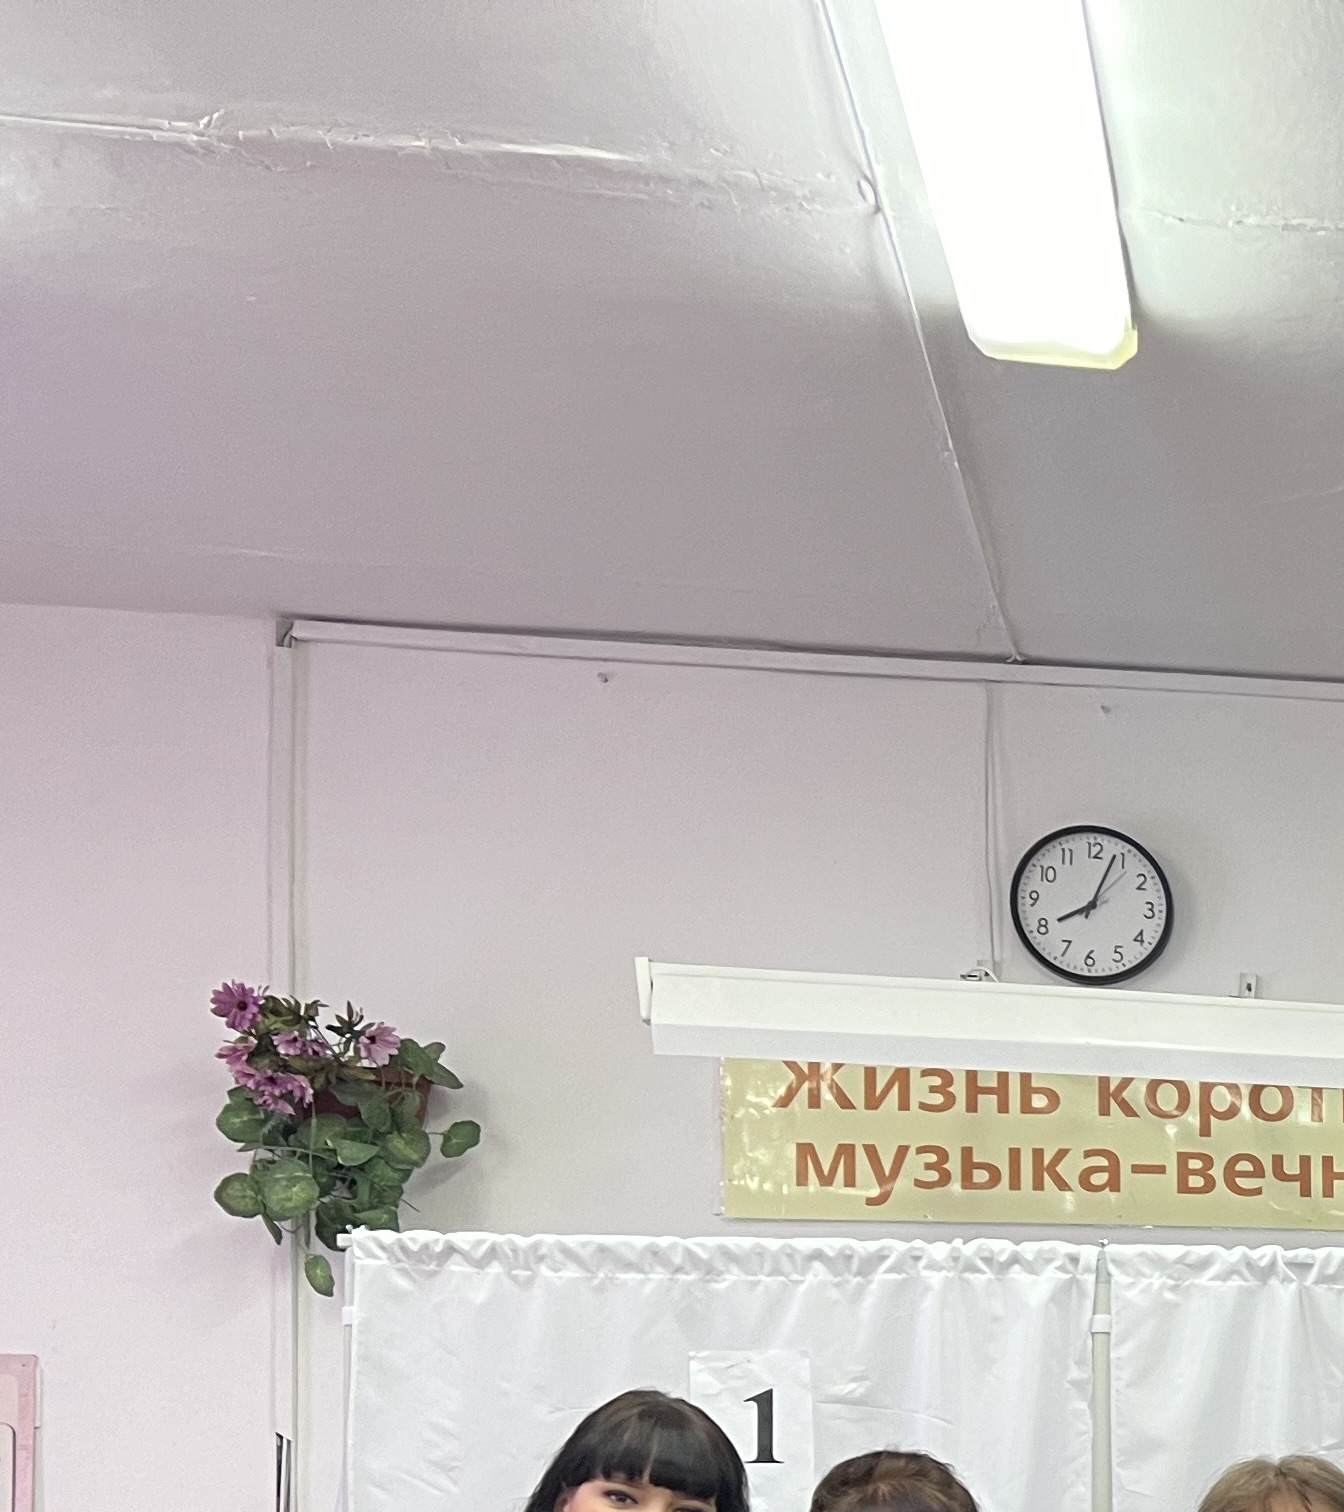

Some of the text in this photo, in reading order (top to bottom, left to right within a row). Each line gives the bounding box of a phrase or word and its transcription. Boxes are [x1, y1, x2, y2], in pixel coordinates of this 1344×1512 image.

[1061, 847, 1073, 866] 11
[1086, 841, 1104, 860] 12
[1039, 865, 1057, 883] 10
[1135, 873, 1148, 891] 2
[1029, 890, 1040, 907] 9
[1143, 901, 1156, 920] 3
[1036, 918, 1049, 935] 8
[1133, 928, 1145, 947] 4
[1061, 939, 1073, 957] 7
[1111, 945, 1124, 963] 5
[1084, 949, 1096, 967] 6
[771, 1060, 1061, 1115] Жизнь
[743, 1388, 785, 1464] 1
